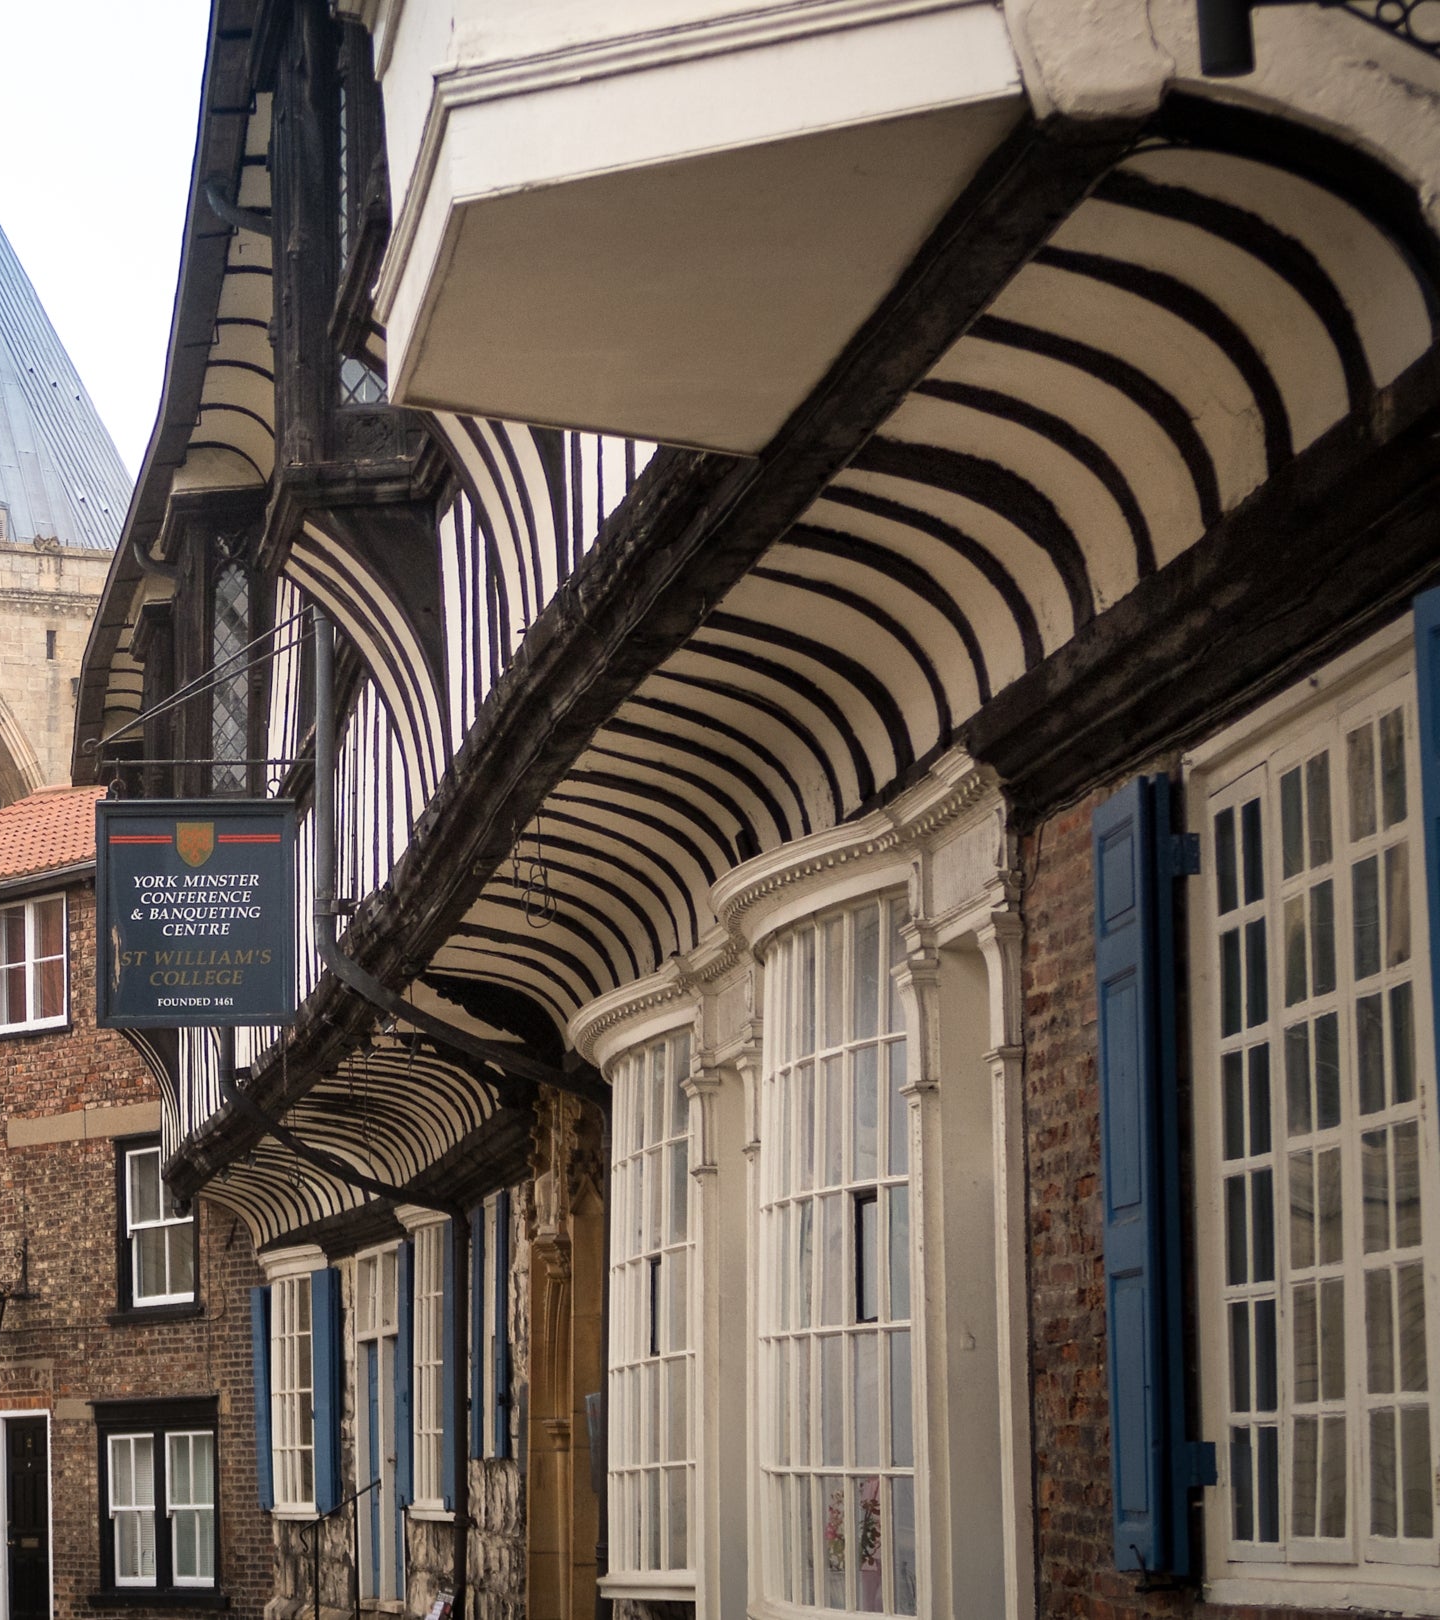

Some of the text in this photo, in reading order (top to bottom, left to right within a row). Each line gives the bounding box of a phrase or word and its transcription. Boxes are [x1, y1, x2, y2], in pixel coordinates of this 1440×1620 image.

[133, 874, 260, 888] YORK MINSTER
[140, 891, 252, 905] CONFERENCE
[130, 906, 261, 922] & BANQUETING
[162, 923, 230, 936] CENTRE
[120, 949, 272, 966] ST WILLIAM'S
[149, 969, 244, 986] COLLEGE
[157, 997, 234, 1007] FOUNDED 1461
